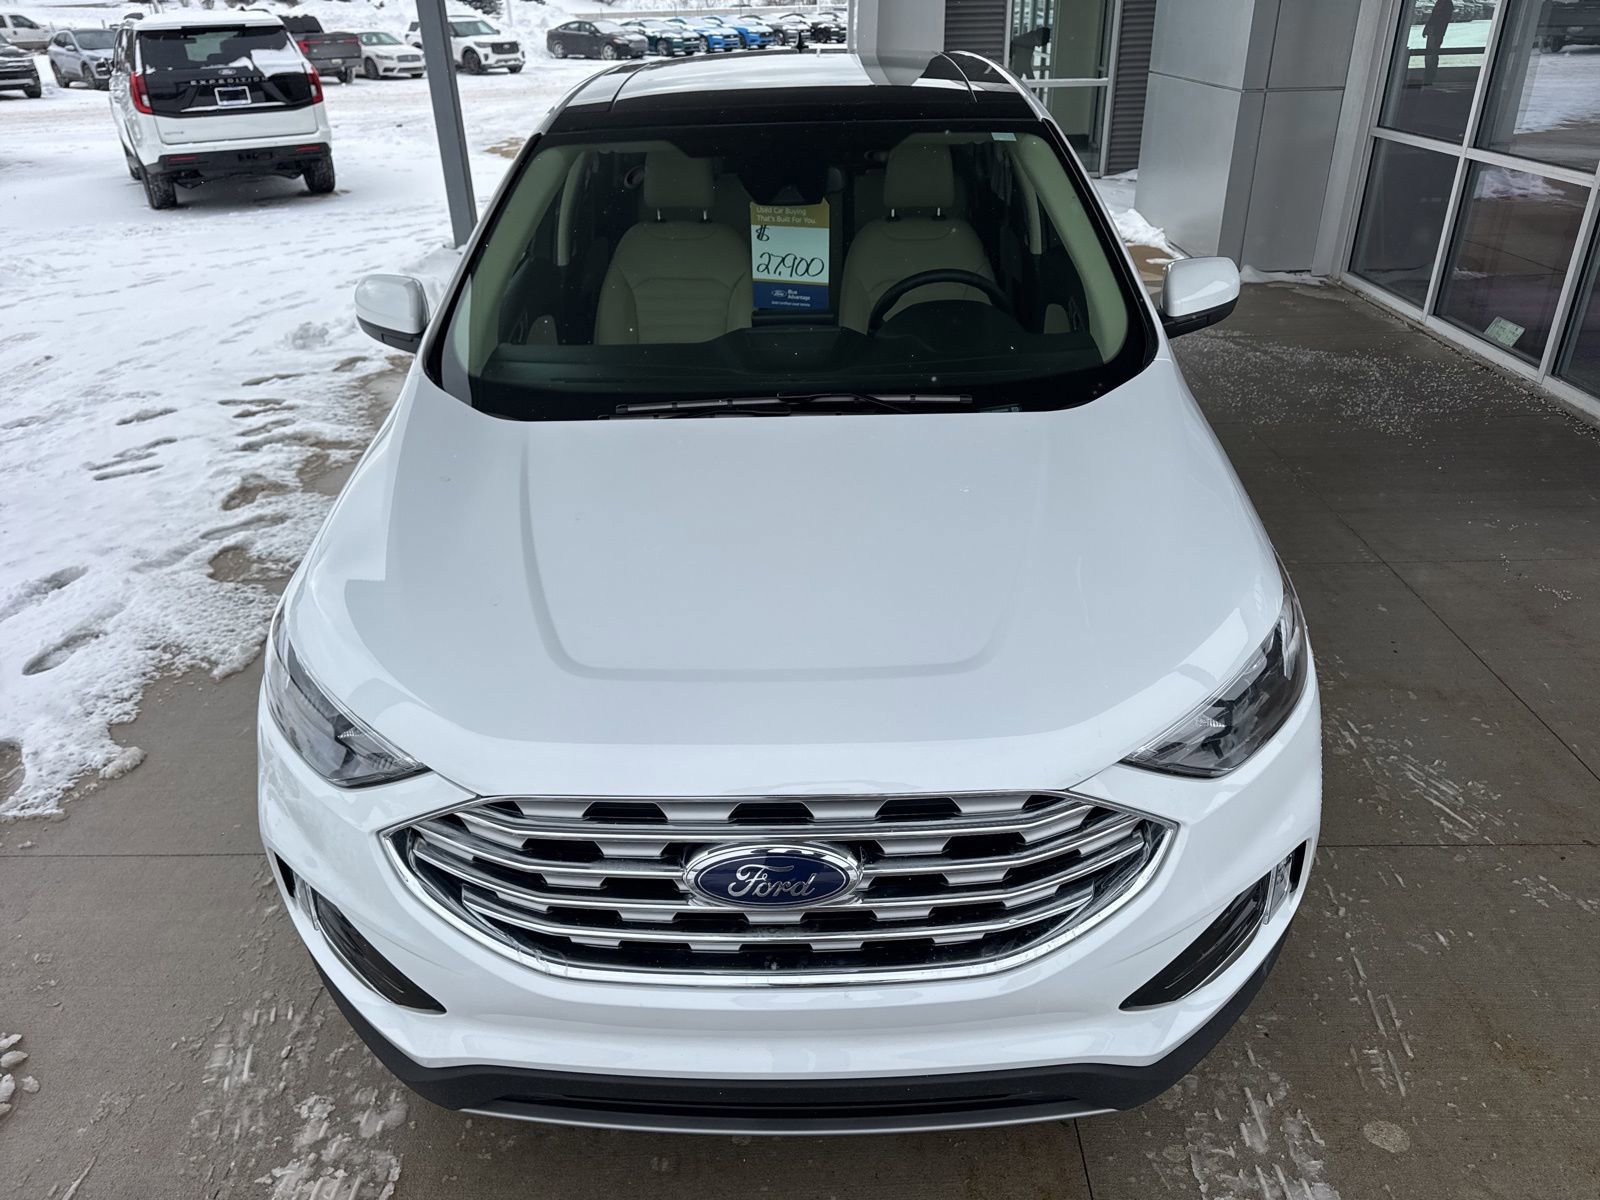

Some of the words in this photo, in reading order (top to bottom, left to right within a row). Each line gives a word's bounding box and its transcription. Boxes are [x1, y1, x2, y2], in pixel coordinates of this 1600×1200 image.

[785, 207, 807, 216] Buying
[756, 214, 775, 223] That's
[776, 215, 791, 223] Built
[755, 224, 770, 242] $
[727, 864, 817, 898] Ford
